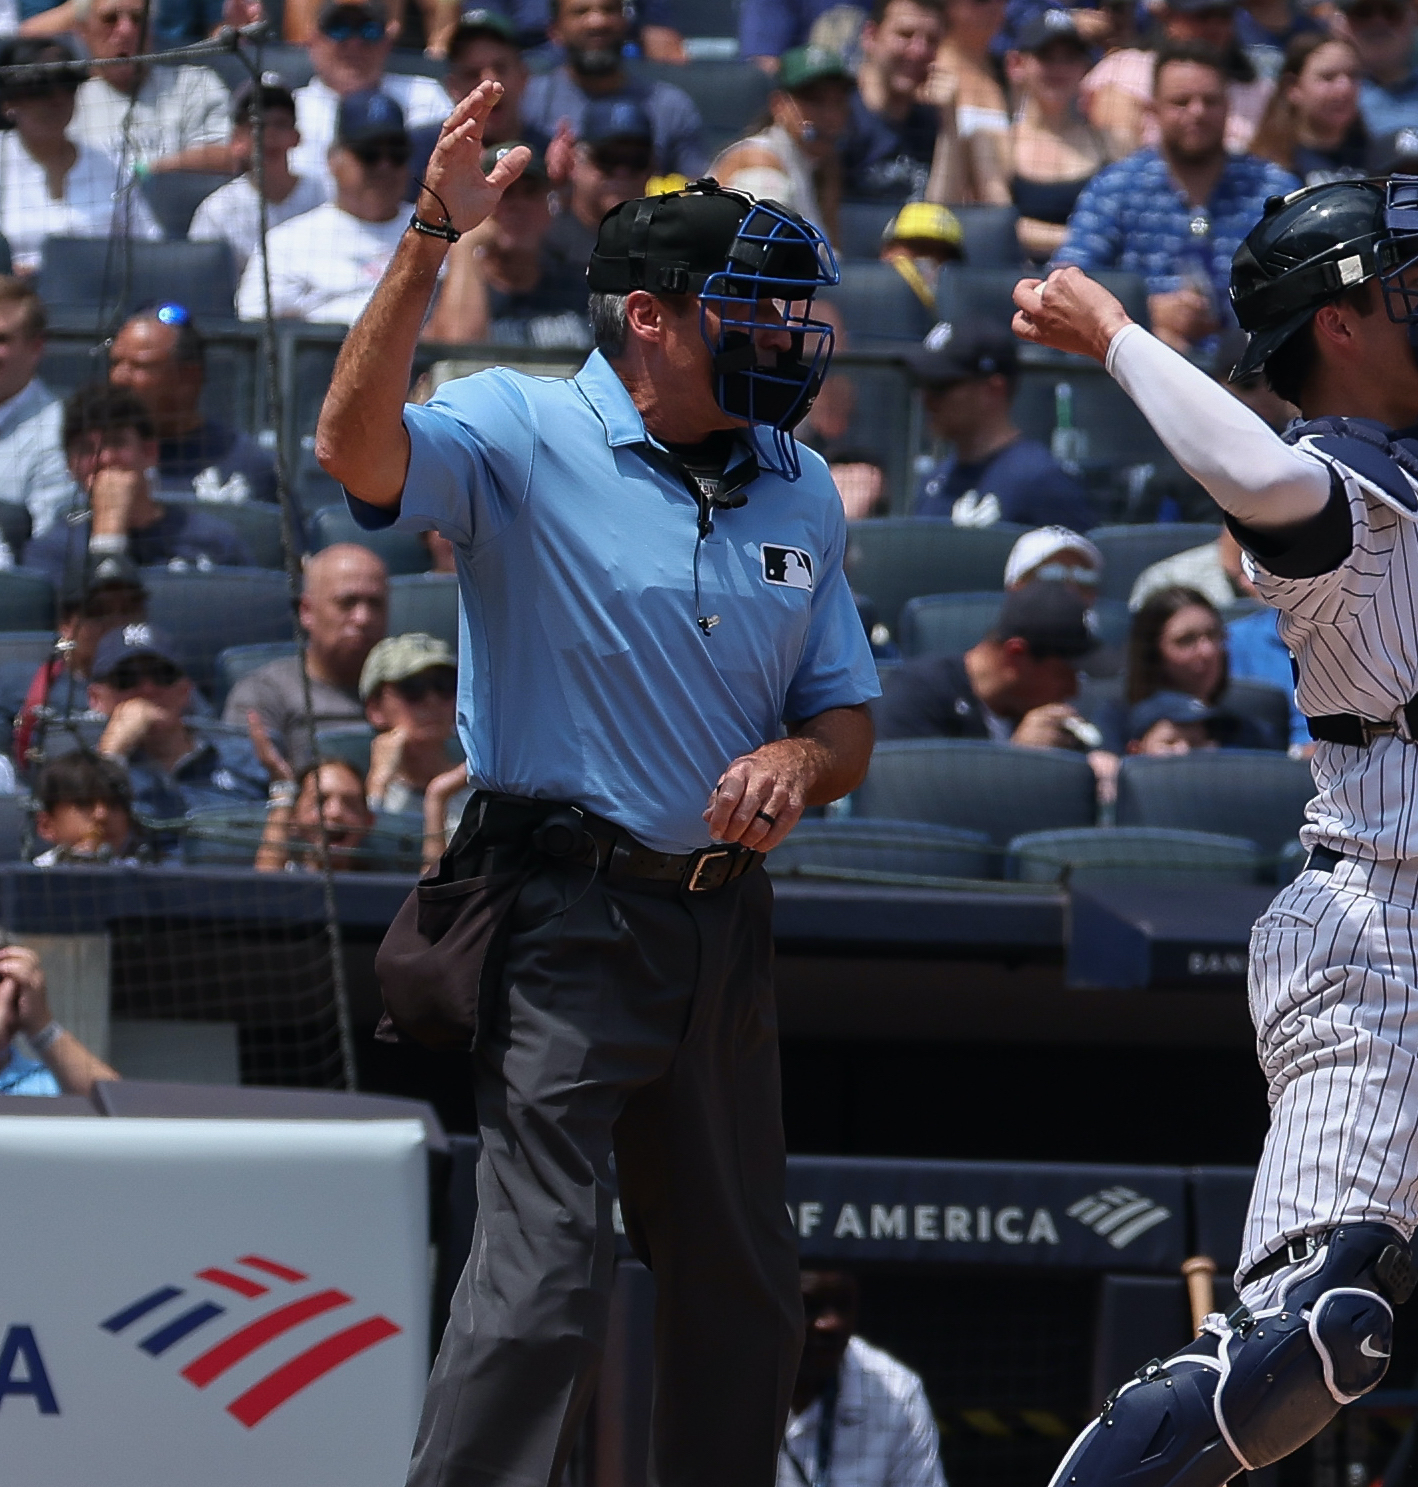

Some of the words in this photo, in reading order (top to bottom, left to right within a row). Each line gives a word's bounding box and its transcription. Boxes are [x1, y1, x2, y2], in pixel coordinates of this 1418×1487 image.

[1188, 952, 1248, 974] BAN
[785, 1201, 822, 1238] F
[833, 1202, 1060, 1245] AMERICA
